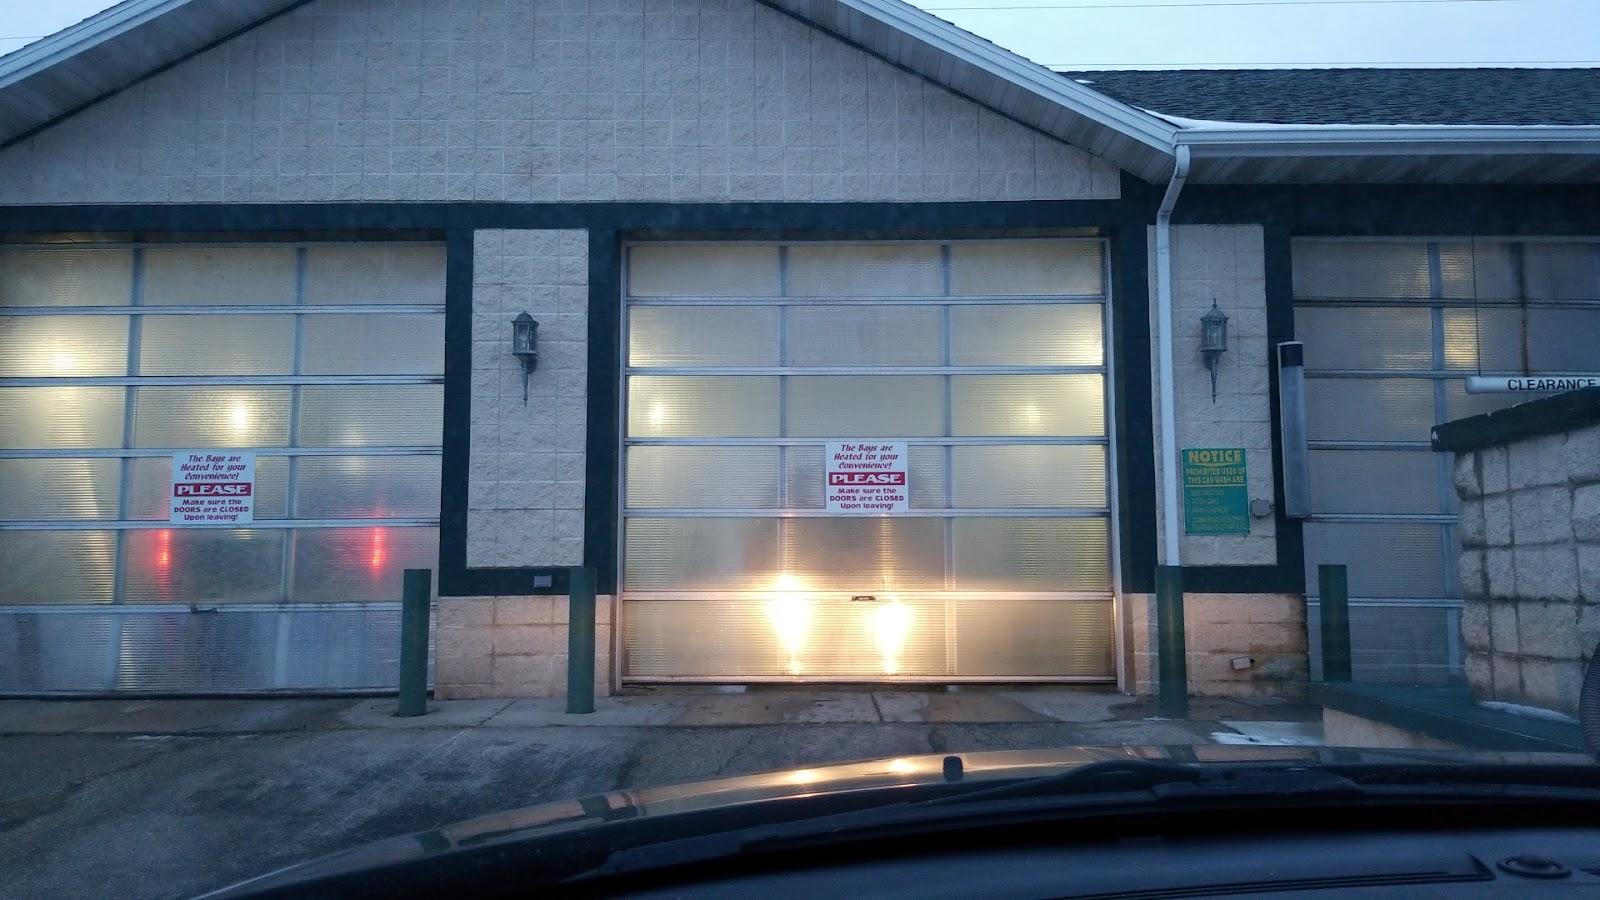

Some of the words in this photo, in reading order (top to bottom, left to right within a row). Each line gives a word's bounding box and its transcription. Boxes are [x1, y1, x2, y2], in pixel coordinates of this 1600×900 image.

[1508, 379, 1596, 390] CLEARANCE
[841, 444, 855, 452] The
[858, 444, 877, 454] Bays
[206, 455, 225, 464] Bays
[834, 453, 862, 461] Heated
[865, 453, 877, 461] for
[1188, 450, 1241, 464] NOTICE
[227, 464, 246, 472] your
[832, 474, 901, 484] PLEASE
[177, 485, 247, 495] PLEASE
